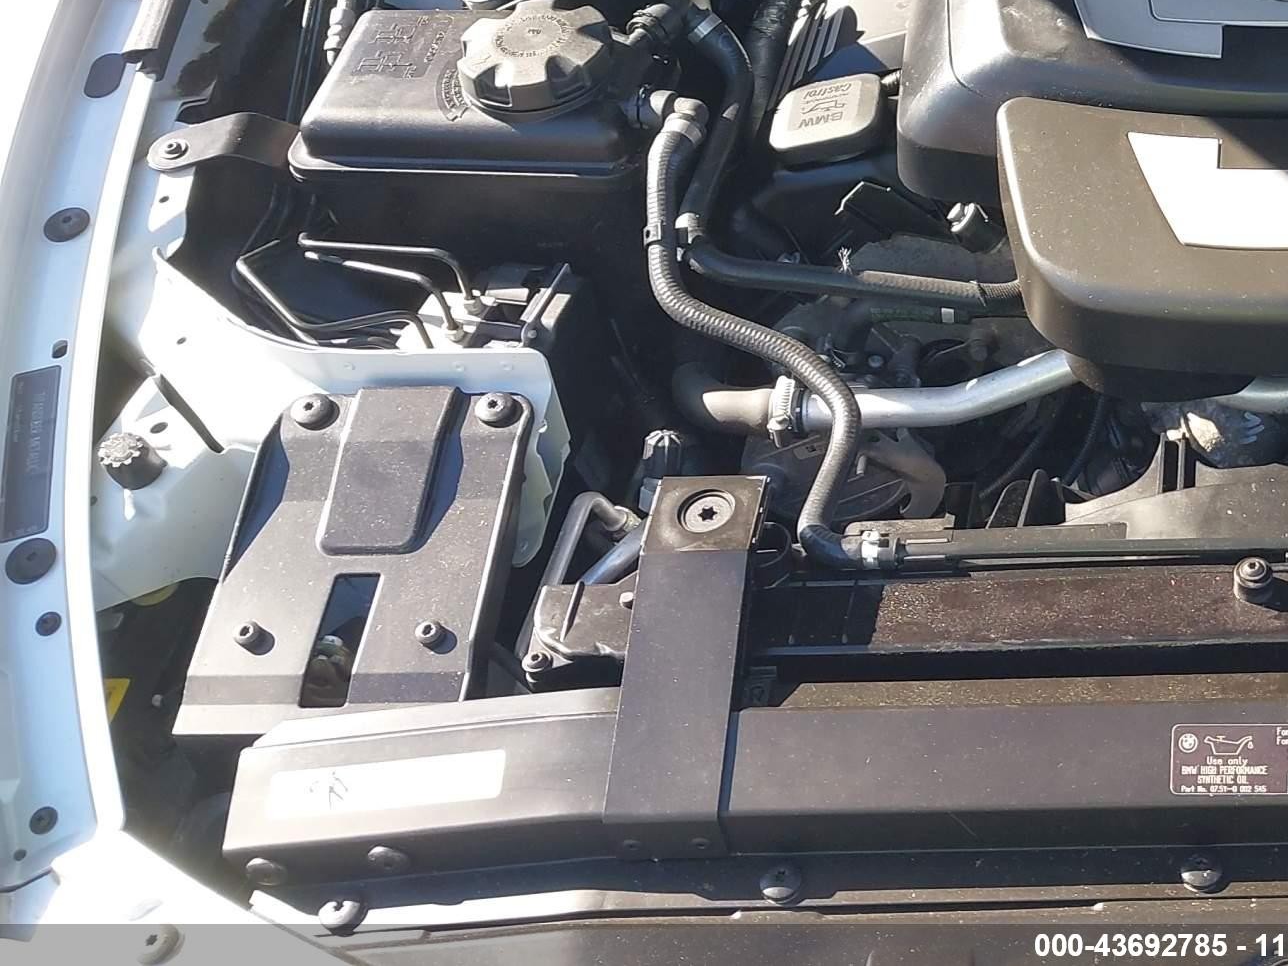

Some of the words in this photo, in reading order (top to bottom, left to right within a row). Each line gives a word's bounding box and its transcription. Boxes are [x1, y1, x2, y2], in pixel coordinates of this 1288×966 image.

[799, 112, 843, 129] BMW
[1206, 756, 1223, 765] Use
[1227, 755, 1248, 767] only
[1200, 765, 1217, 775] HIGH
[1219, 765, 1269, 775] PERFORMANCE
[1197, 775, 1234, 784] SYNTHETIC
[1236, 775, 1249, 784] OIL
[1180, 784, 1195, 793] Part
